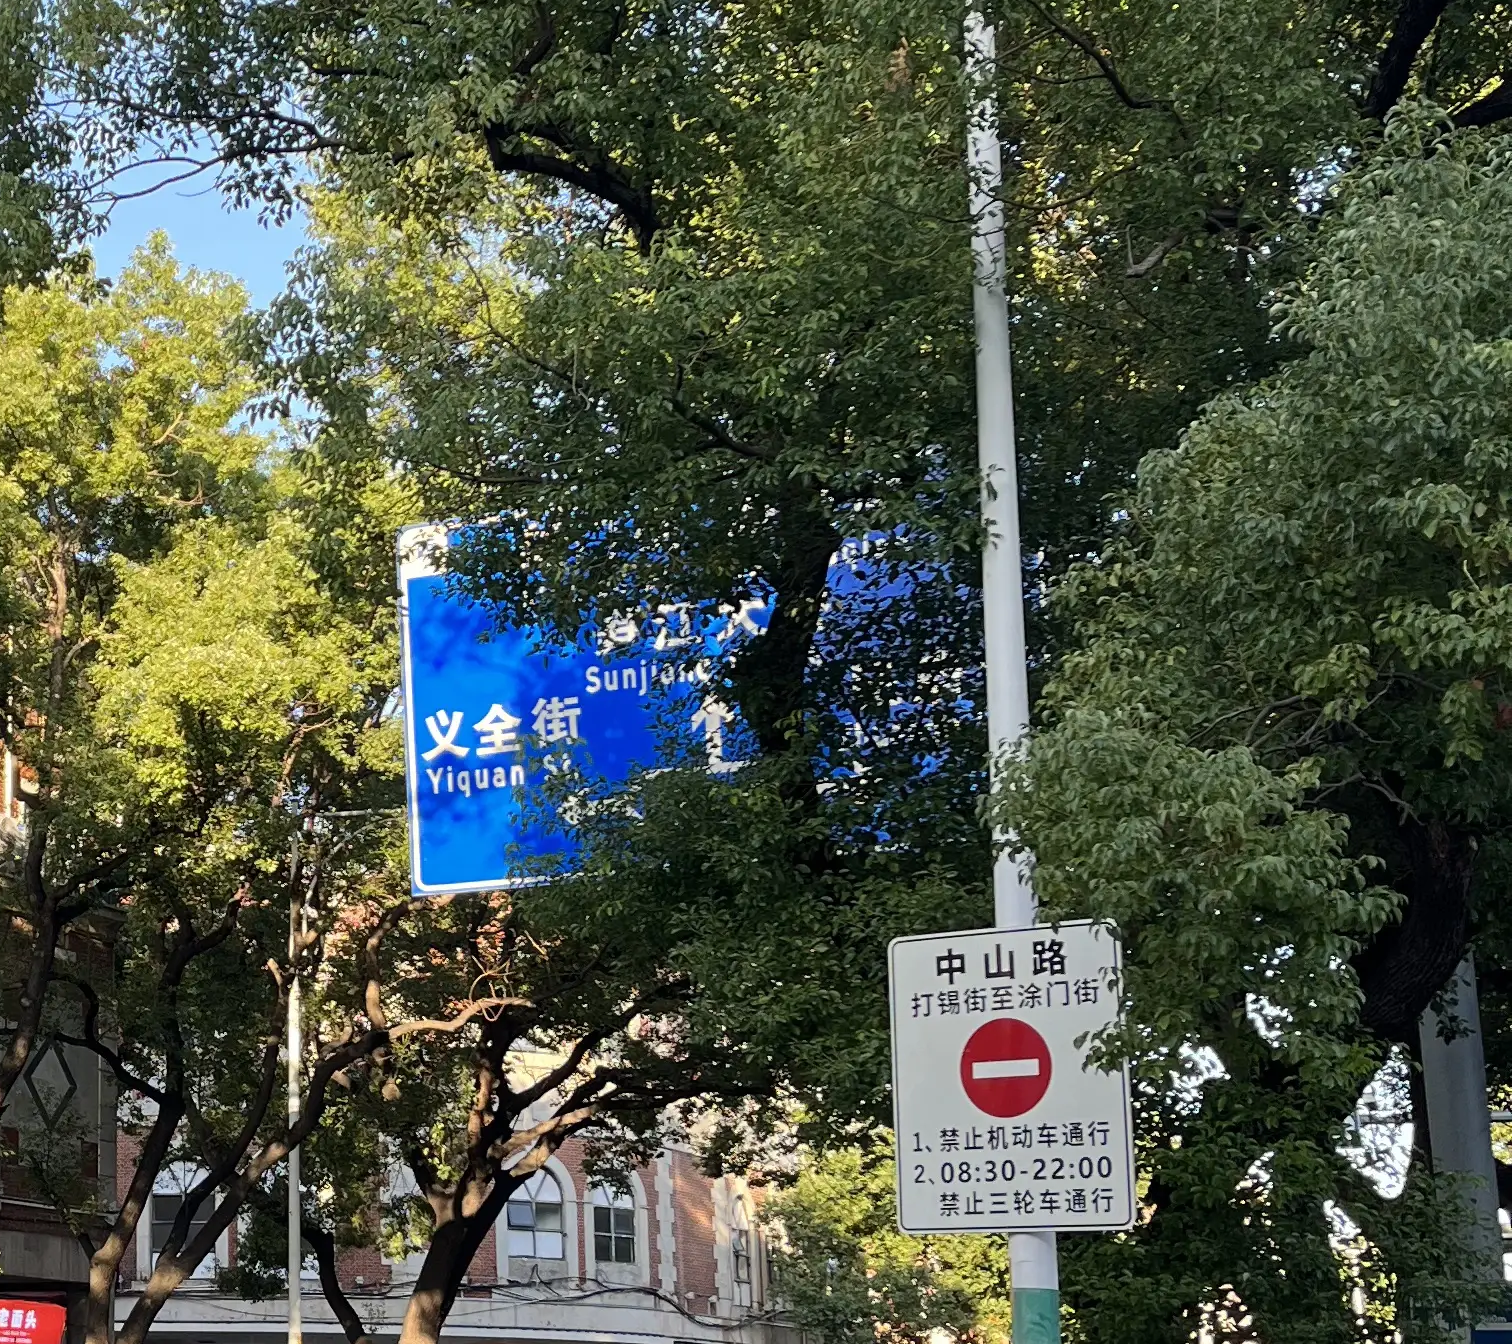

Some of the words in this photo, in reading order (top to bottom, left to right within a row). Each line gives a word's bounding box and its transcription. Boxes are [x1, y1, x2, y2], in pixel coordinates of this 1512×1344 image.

[421, 695, 582, 762] 义全街
[426, 762, 526, 798] Yiquan
[935, 938, 1068, 985] 中山路
[911, 977, 1100, 1018] 打锡街至涂门街
[912, 1120, 1110, 1154] 1、禁止机动车通行
[939, 1187, 1114, 1218] 禁止三轮车通行
